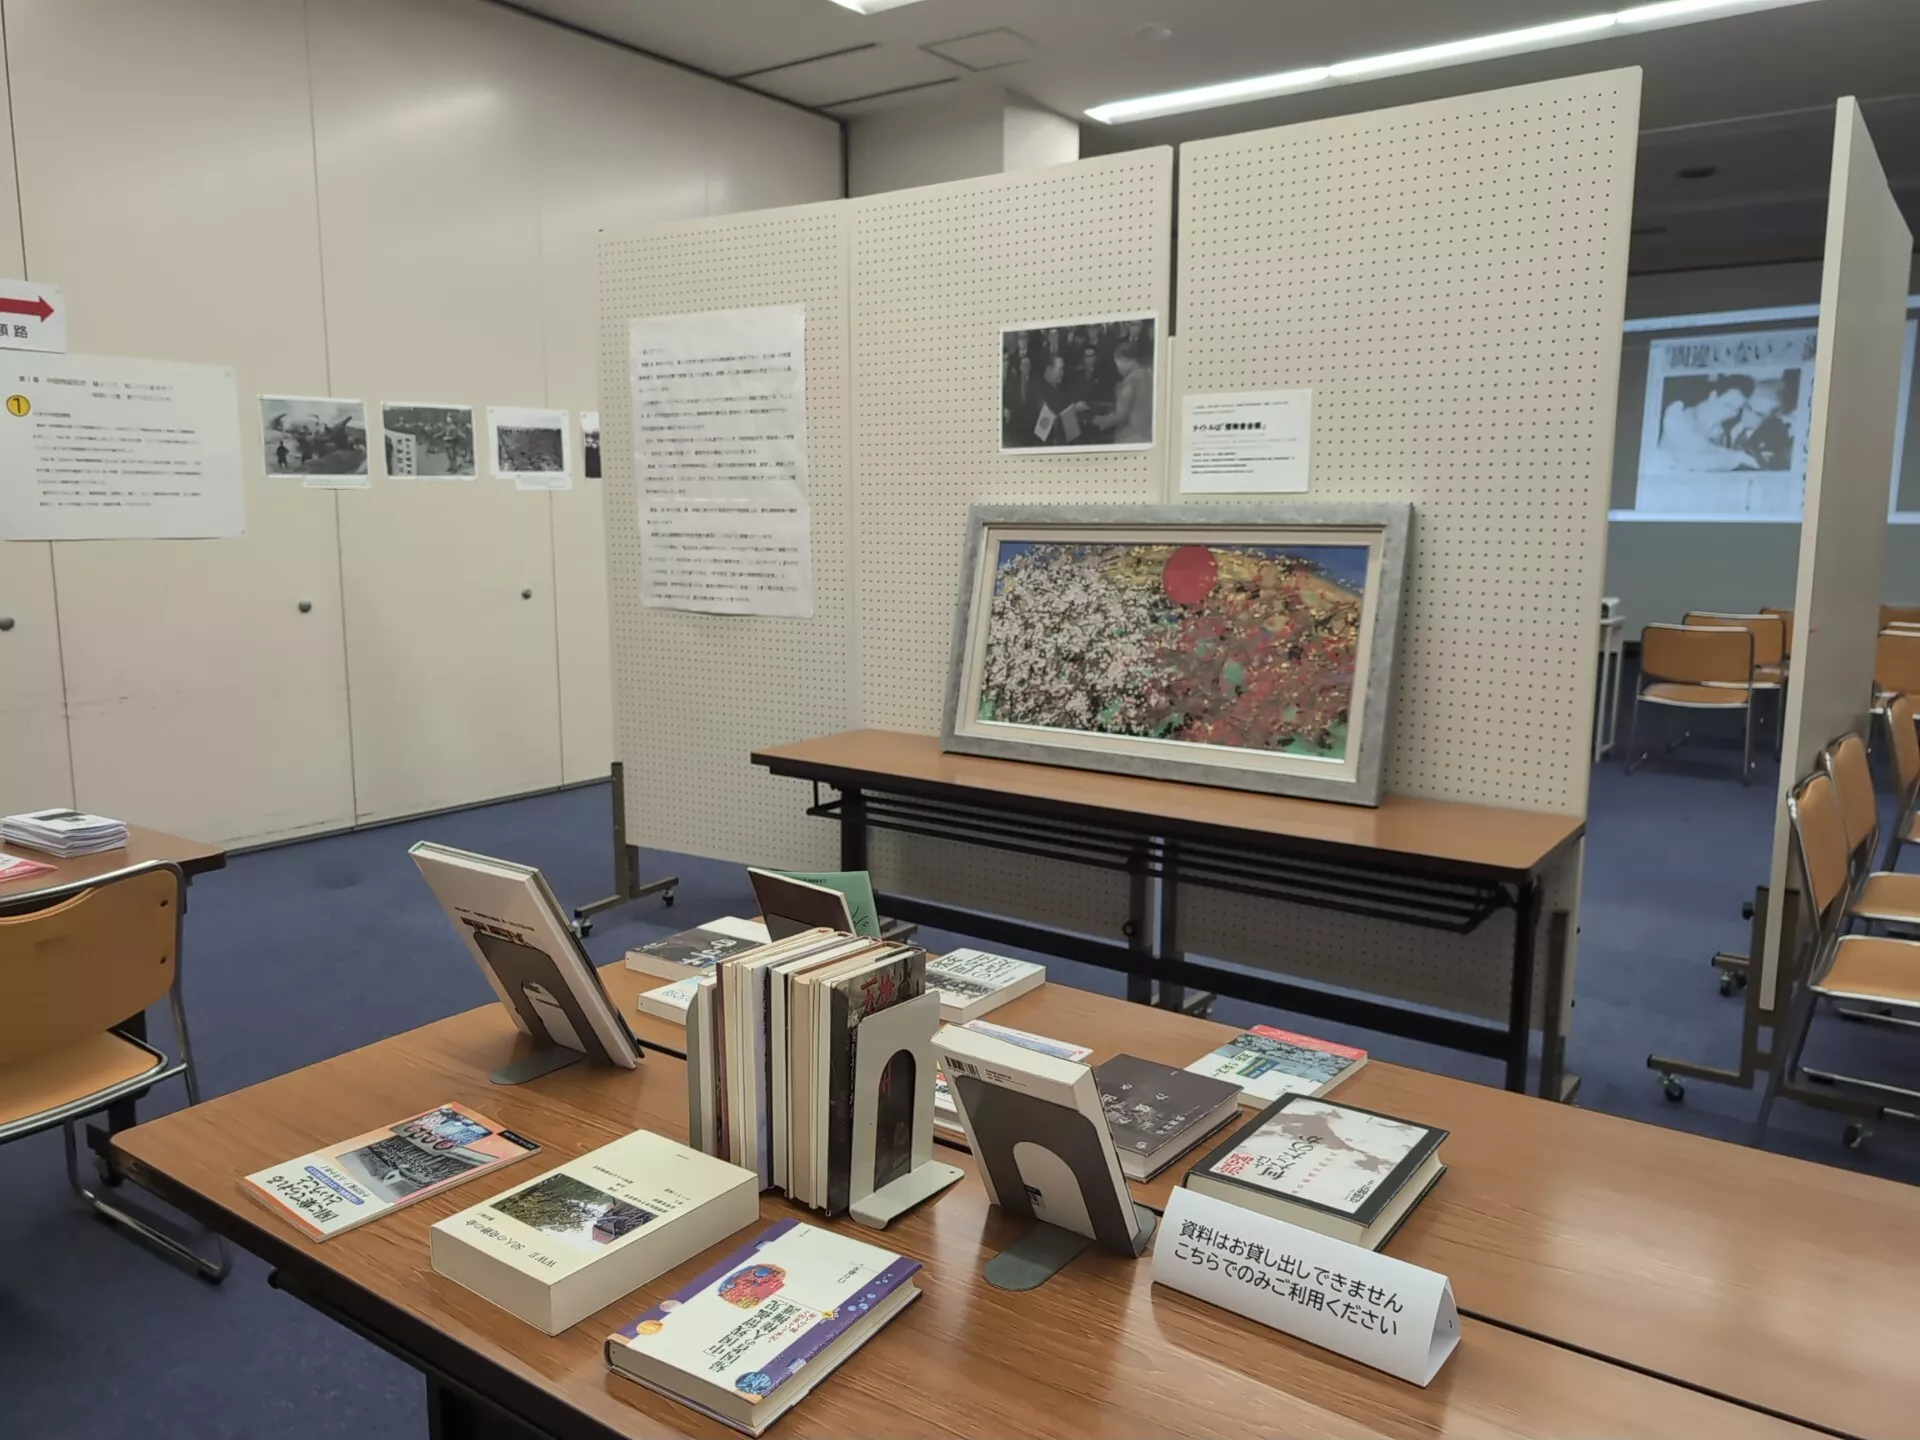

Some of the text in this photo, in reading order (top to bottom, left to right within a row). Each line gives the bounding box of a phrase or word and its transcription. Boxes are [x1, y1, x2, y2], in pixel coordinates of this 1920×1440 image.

[291, 1175, 344, 1206] ということ
[1255, 1132, 1324, 1181] 何だったのか
[1174, 1241, 1398, 1336] こちらでのみご利用ください
[1178, 1218, 1403, 1313] 資料はお貸し出しできません
